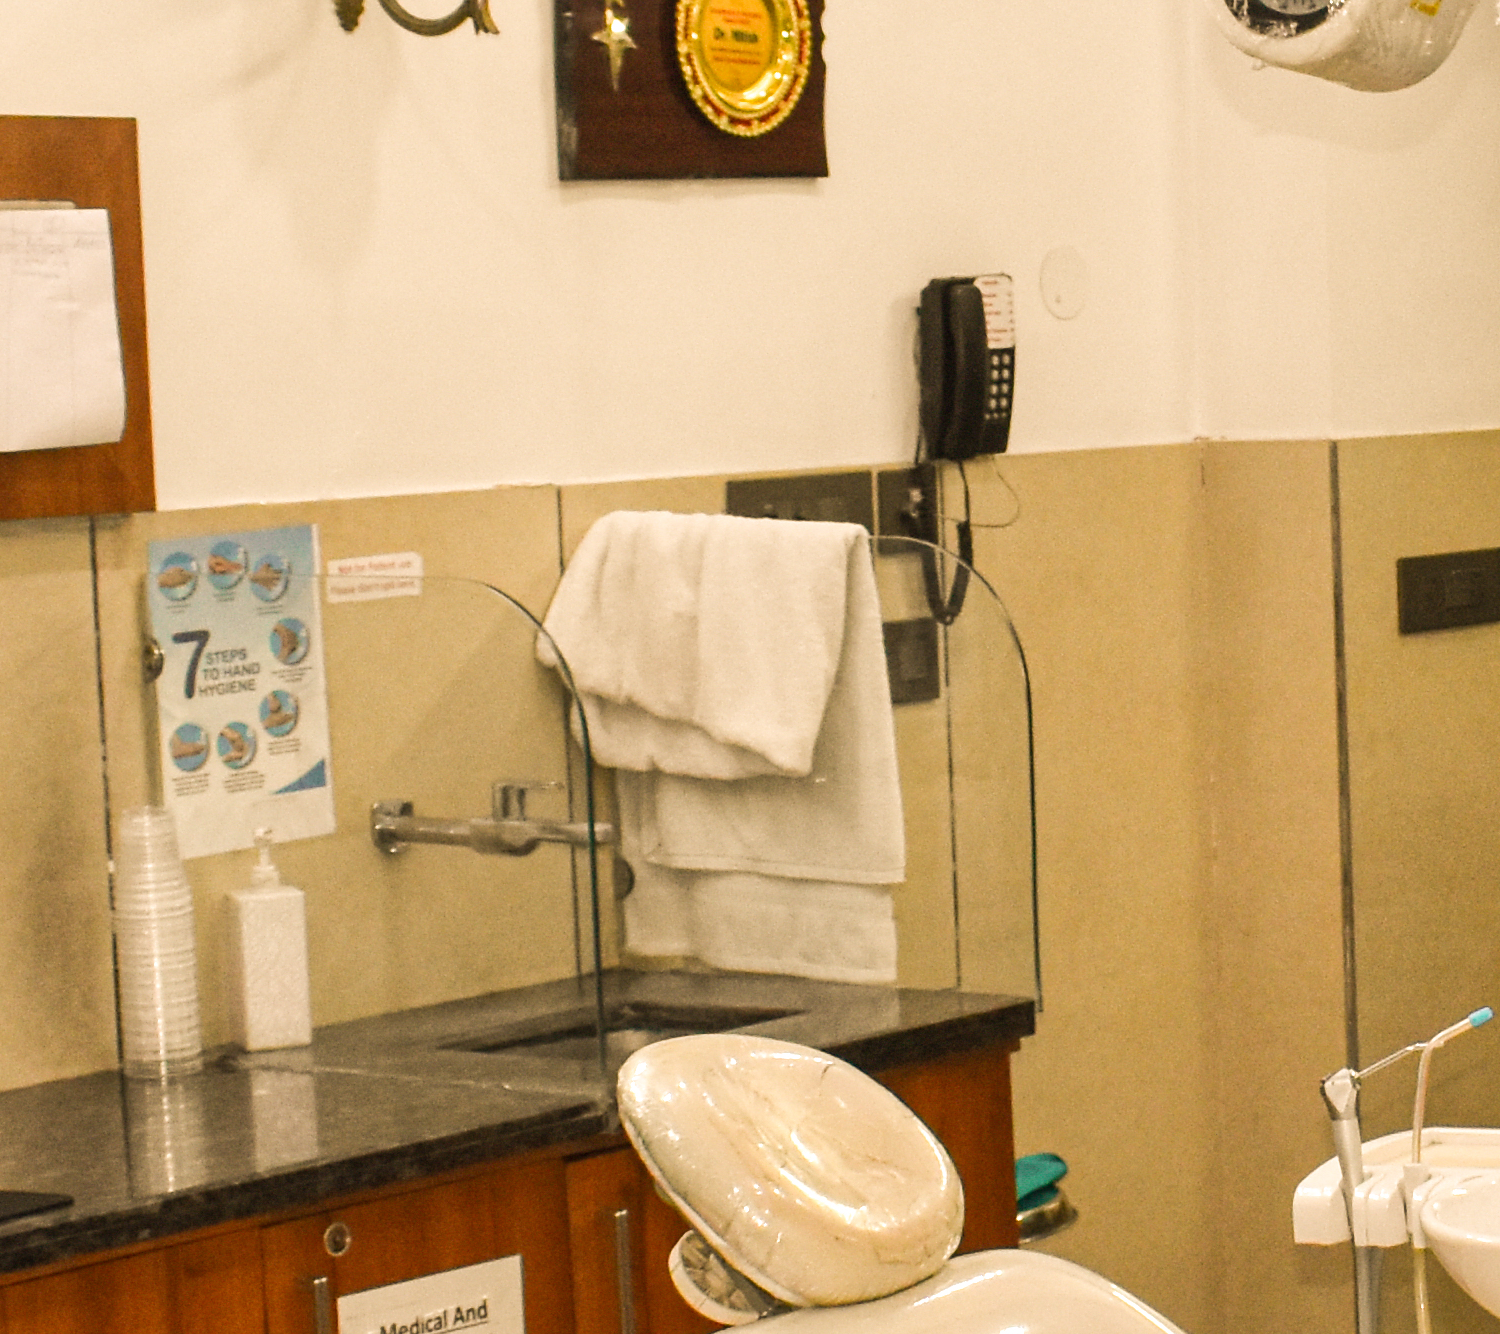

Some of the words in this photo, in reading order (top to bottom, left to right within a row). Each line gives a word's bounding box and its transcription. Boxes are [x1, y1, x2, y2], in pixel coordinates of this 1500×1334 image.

[172, 630, 210, 699] 7
[206, 649, 248, 665] STEPS
[203, 667, 221, 681] TO
[223, 662, 260, 678] HAND
[198, 679, 257, 697] HYGIENE
[453, 1298, 489, 1327] And
